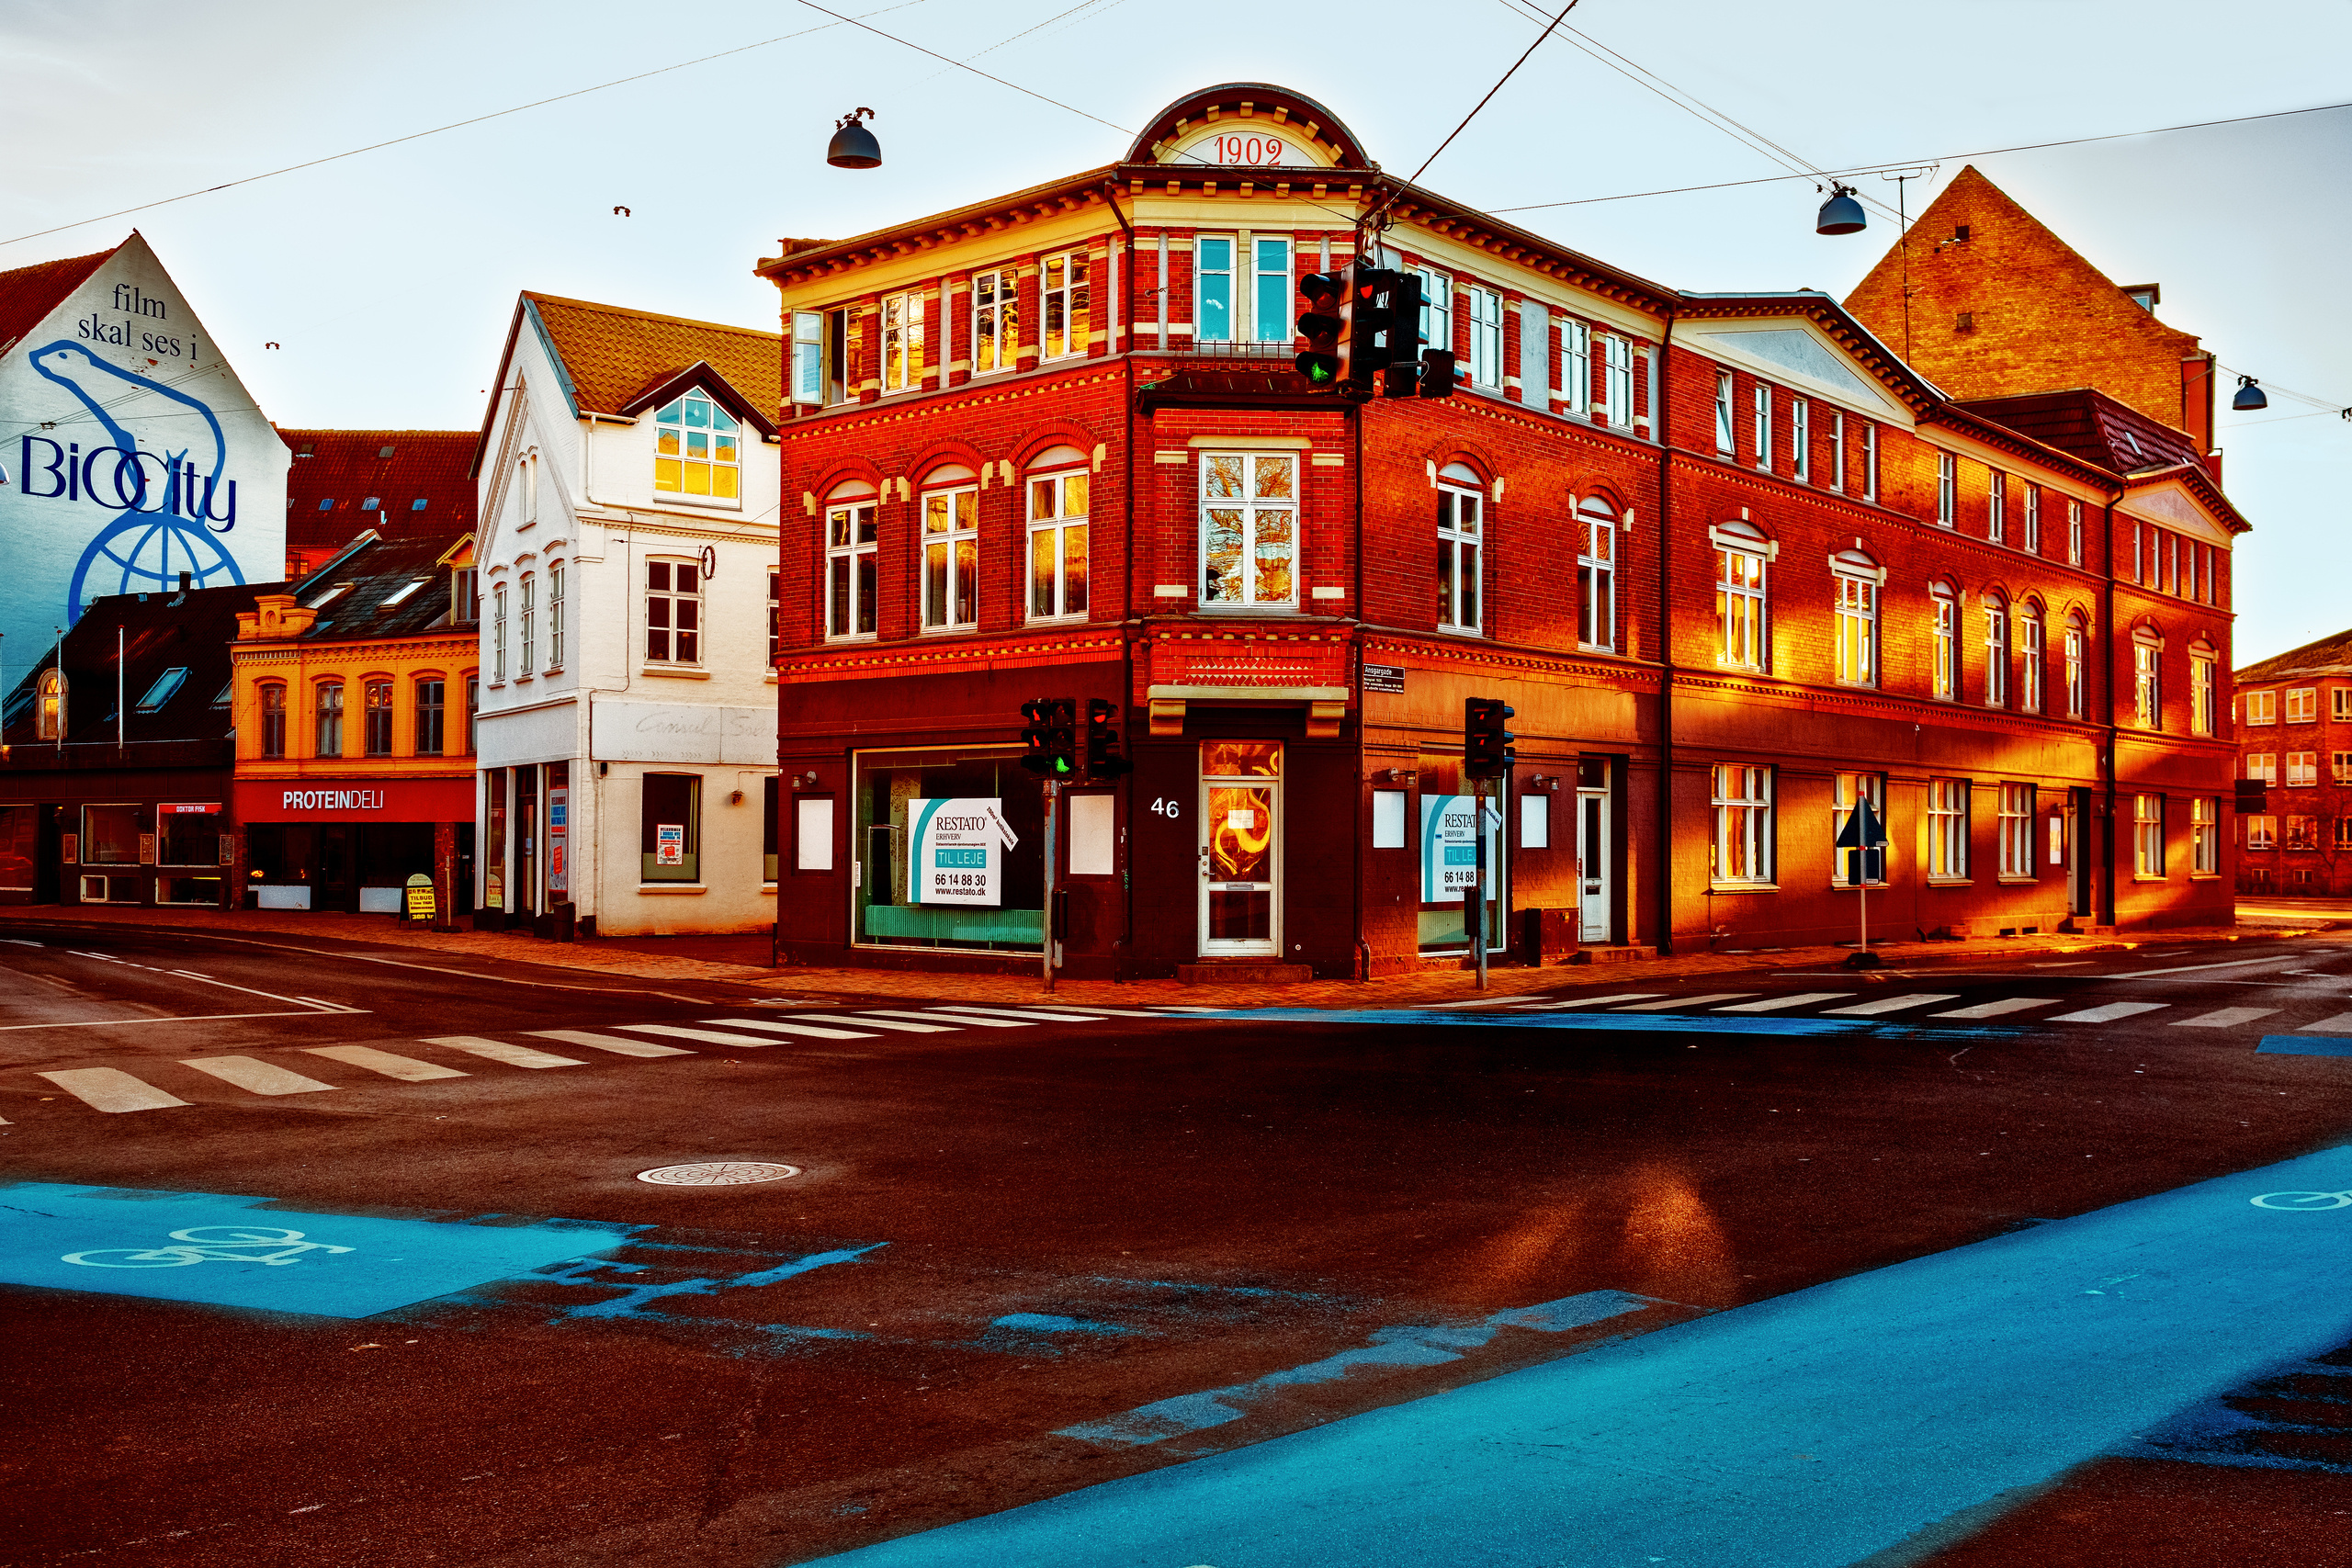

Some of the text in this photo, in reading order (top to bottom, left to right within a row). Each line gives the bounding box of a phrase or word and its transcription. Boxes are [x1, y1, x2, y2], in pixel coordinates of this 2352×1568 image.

[1214, 136, 1283, 166] 1902
[112, 283, 167, 320] film
[78, 312, 198, 361] skal ses i
[1364, 666, 1393, 676] Ansgargade
[283, 790, 384, 809] PROTEINDELI
[1150, 796, 1180, 818] 46
[1444, 814, 1476, 828] RESTAT
[1444, 829, 1465, 838] ERHVERV
[938, 852, 984, 864] TIL LEJE
[1446, 849, 1460, 863] TIL
[935, 874, 986, 886] 66 14 88 30
[1444, 871, 1475, 884] 66 14 88
[935, 887, 986, 897] www.restato.dk
